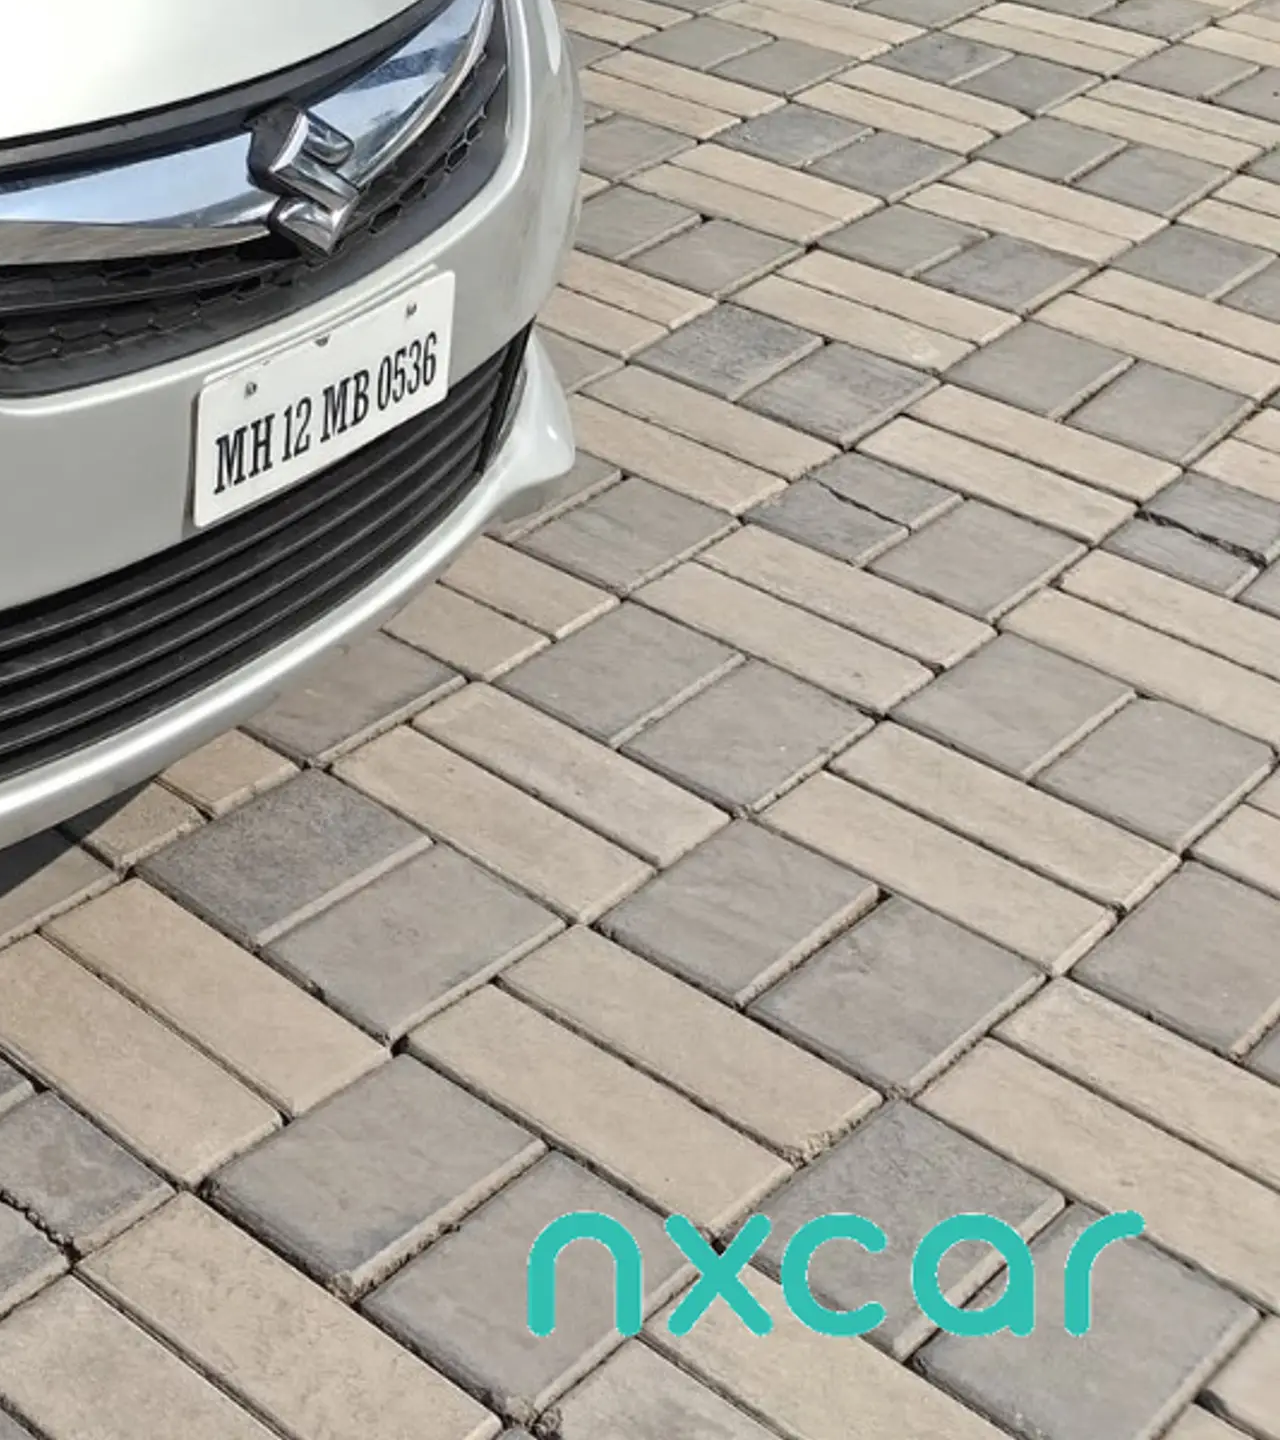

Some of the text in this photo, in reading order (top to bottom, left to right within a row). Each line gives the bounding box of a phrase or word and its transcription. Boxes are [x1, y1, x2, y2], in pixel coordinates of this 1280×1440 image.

[213, 331, 438, 494] MH 12 MB 0536
